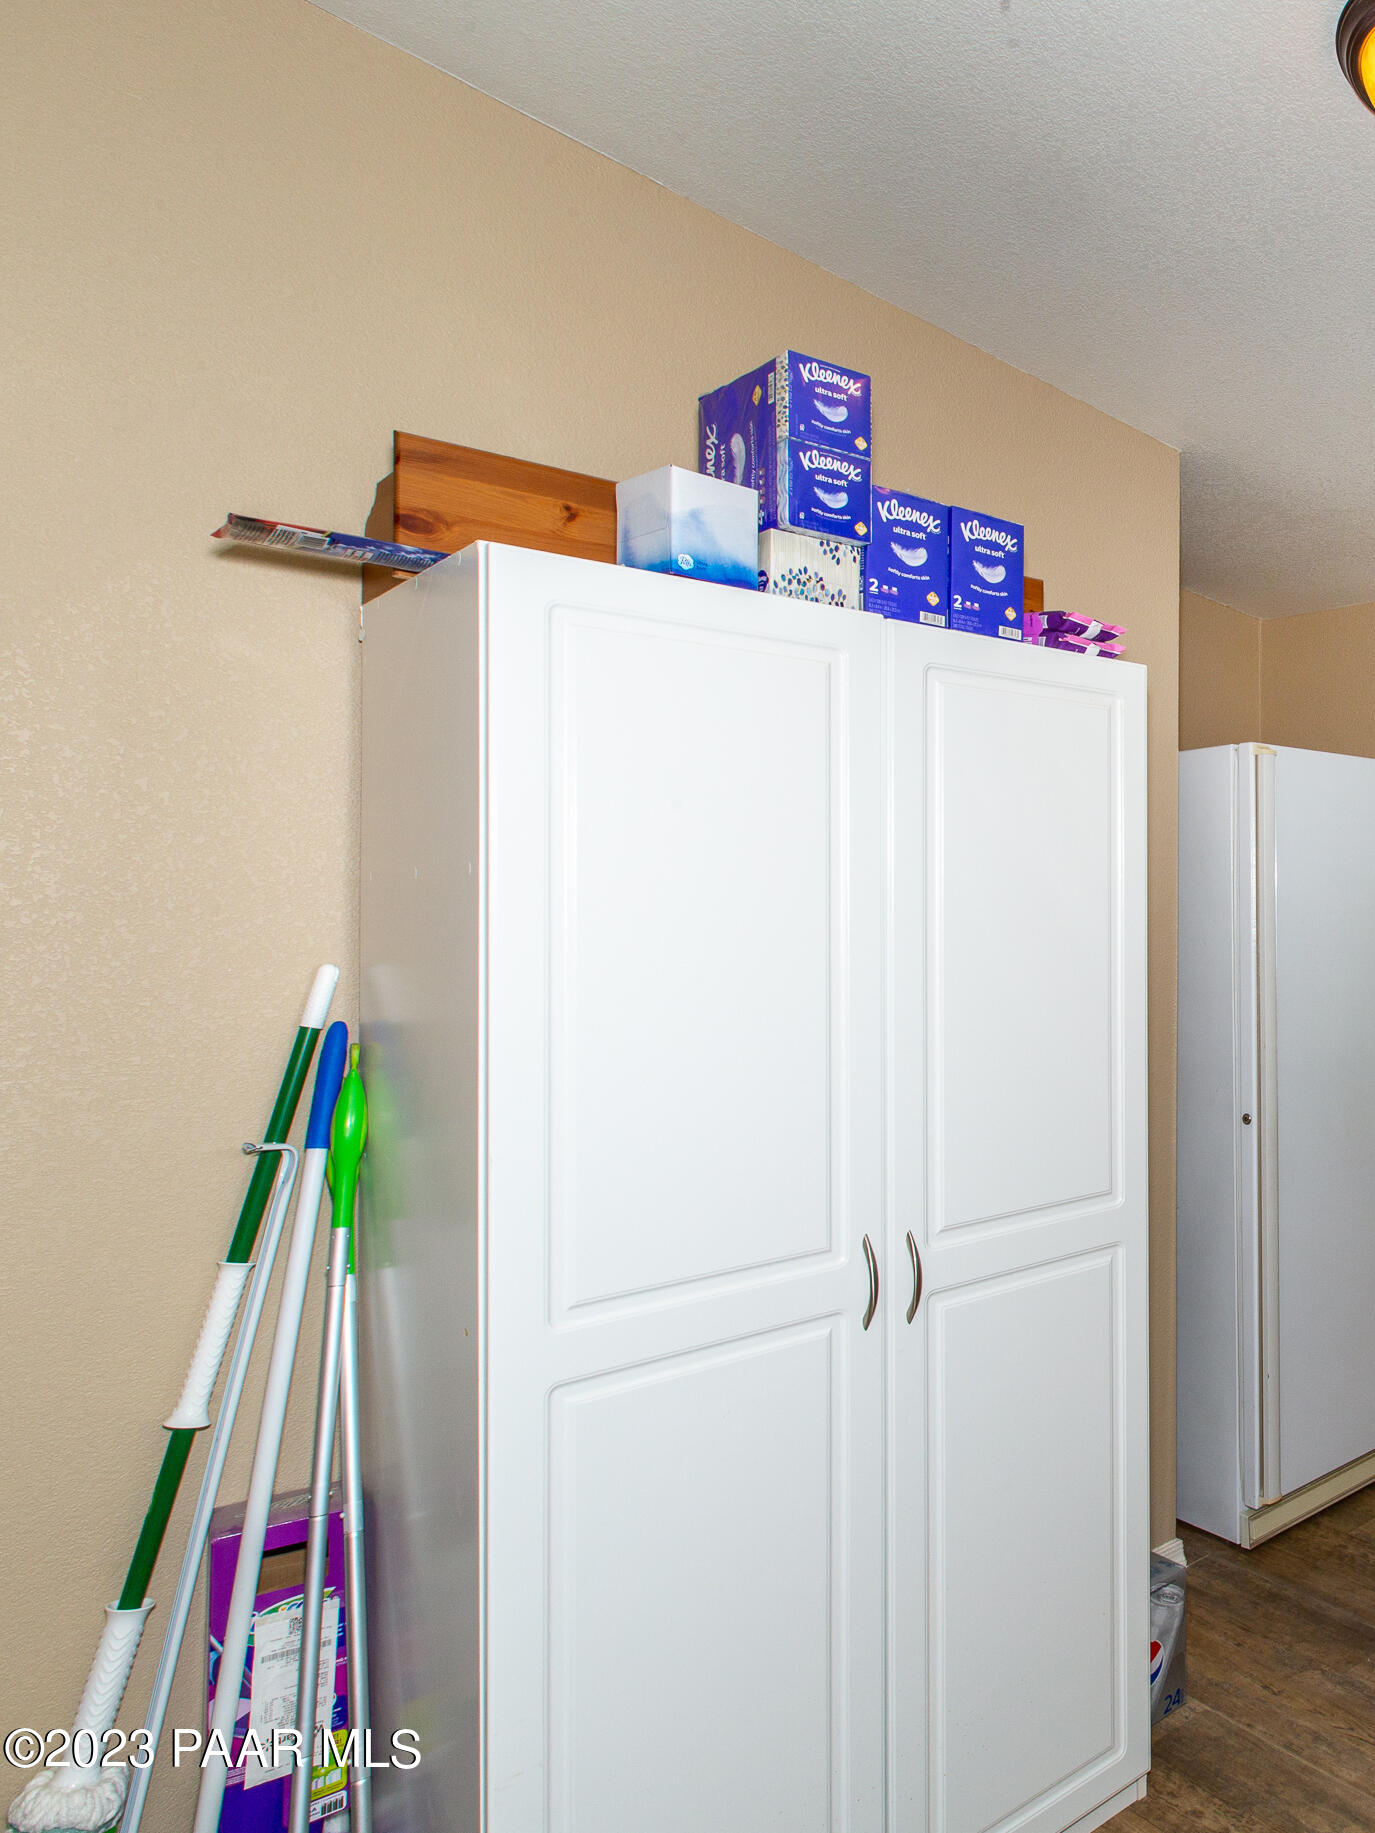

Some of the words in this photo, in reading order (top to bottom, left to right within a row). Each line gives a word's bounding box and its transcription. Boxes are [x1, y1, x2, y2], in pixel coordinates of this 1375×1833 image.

[799, 362, 861, 394] Kleenex
[815, 387, 832, 397] ultra
[833, 392, 847, 401] soft
[799, 450, 861, 480] Kleenex
[815, 474, 832, 484] ultra
[833, 479, 848, 487] soft
[877, 499, 941, 533] Kleenex
[893, 526, 911, 537] ultra
[912, 531, 926, 540] soft
[960, 519, 1017, 551] Kleenex
[974, 545, 991, 556] ultra
[991, 550, 1005, 559] soft
[869, 578, 879, 592] 2
[953, 594, 962, 608] 2
[1163, 1687, 1181, 1714] 24
